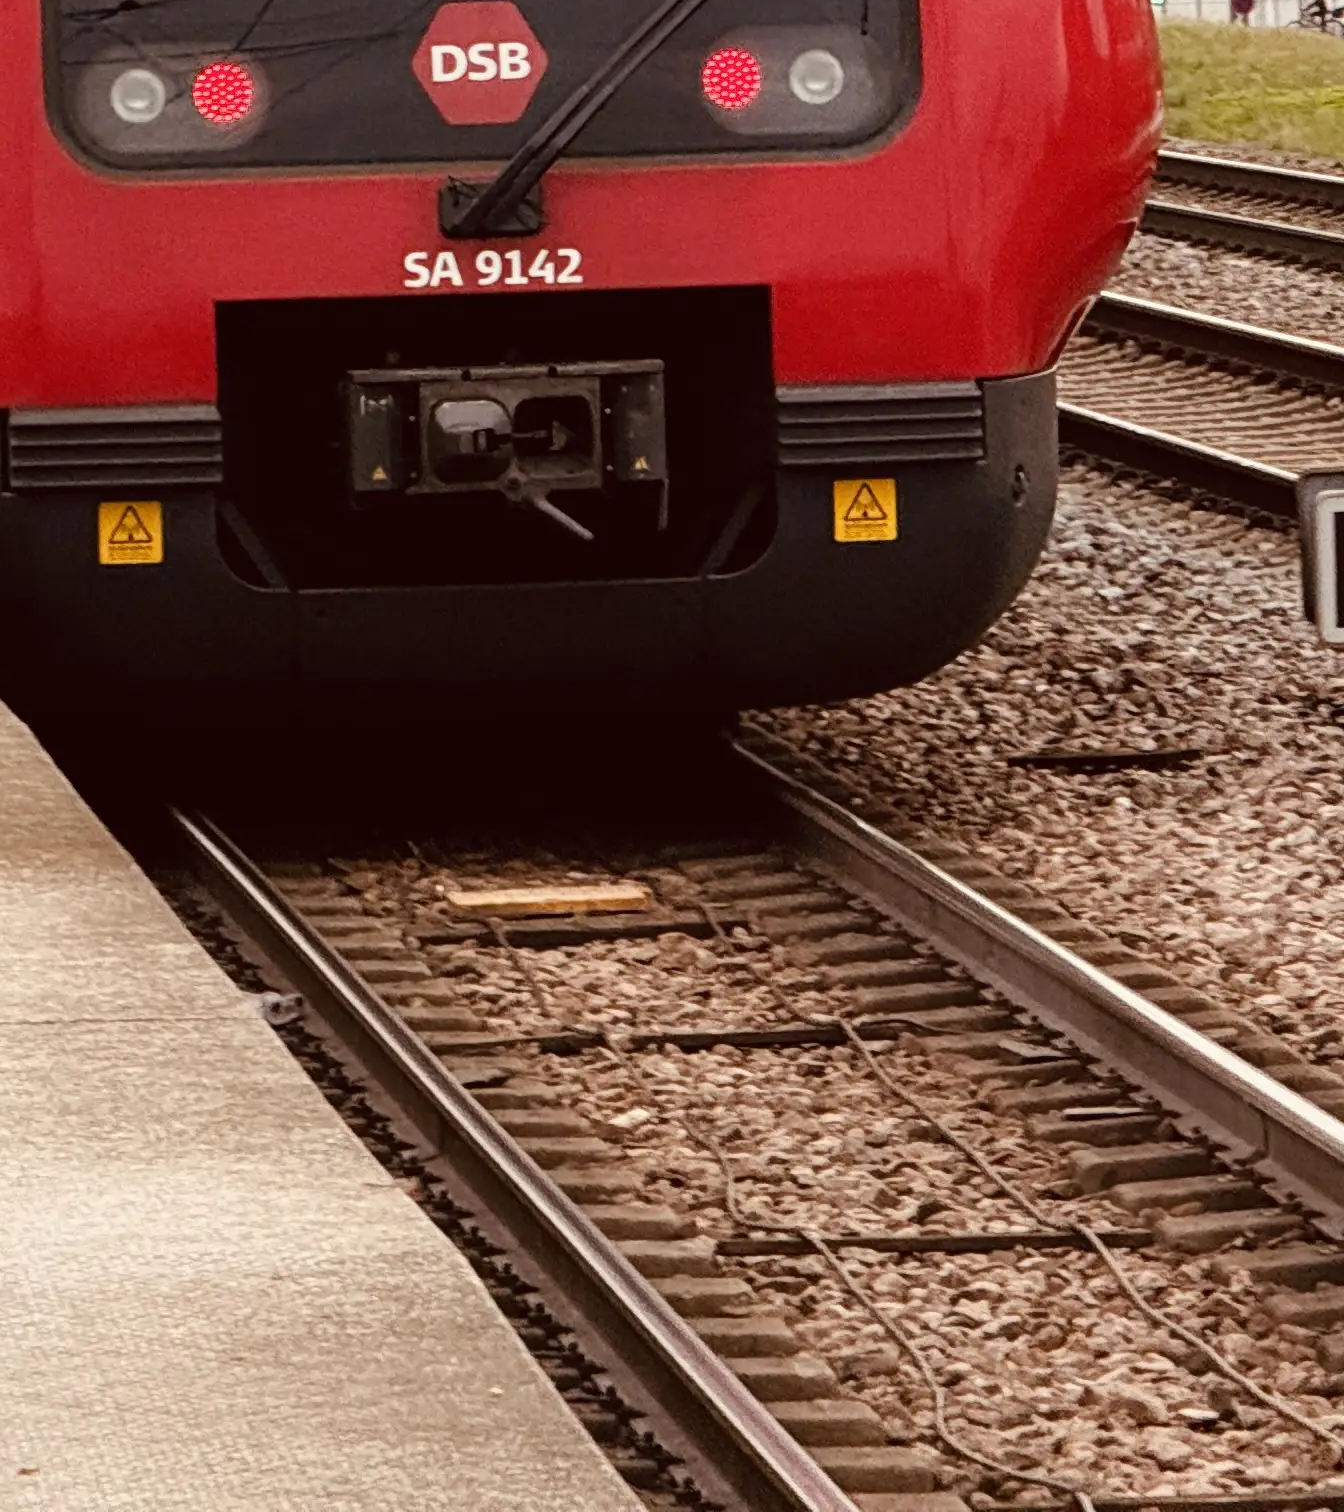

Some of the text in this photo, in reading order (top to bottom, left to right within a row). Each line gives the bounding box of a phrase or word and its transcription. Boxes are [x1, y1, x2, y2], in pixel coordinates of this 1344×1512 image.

[431, 42, 532, 83] DSB
[404, 248, 584, 288] SA 9142
